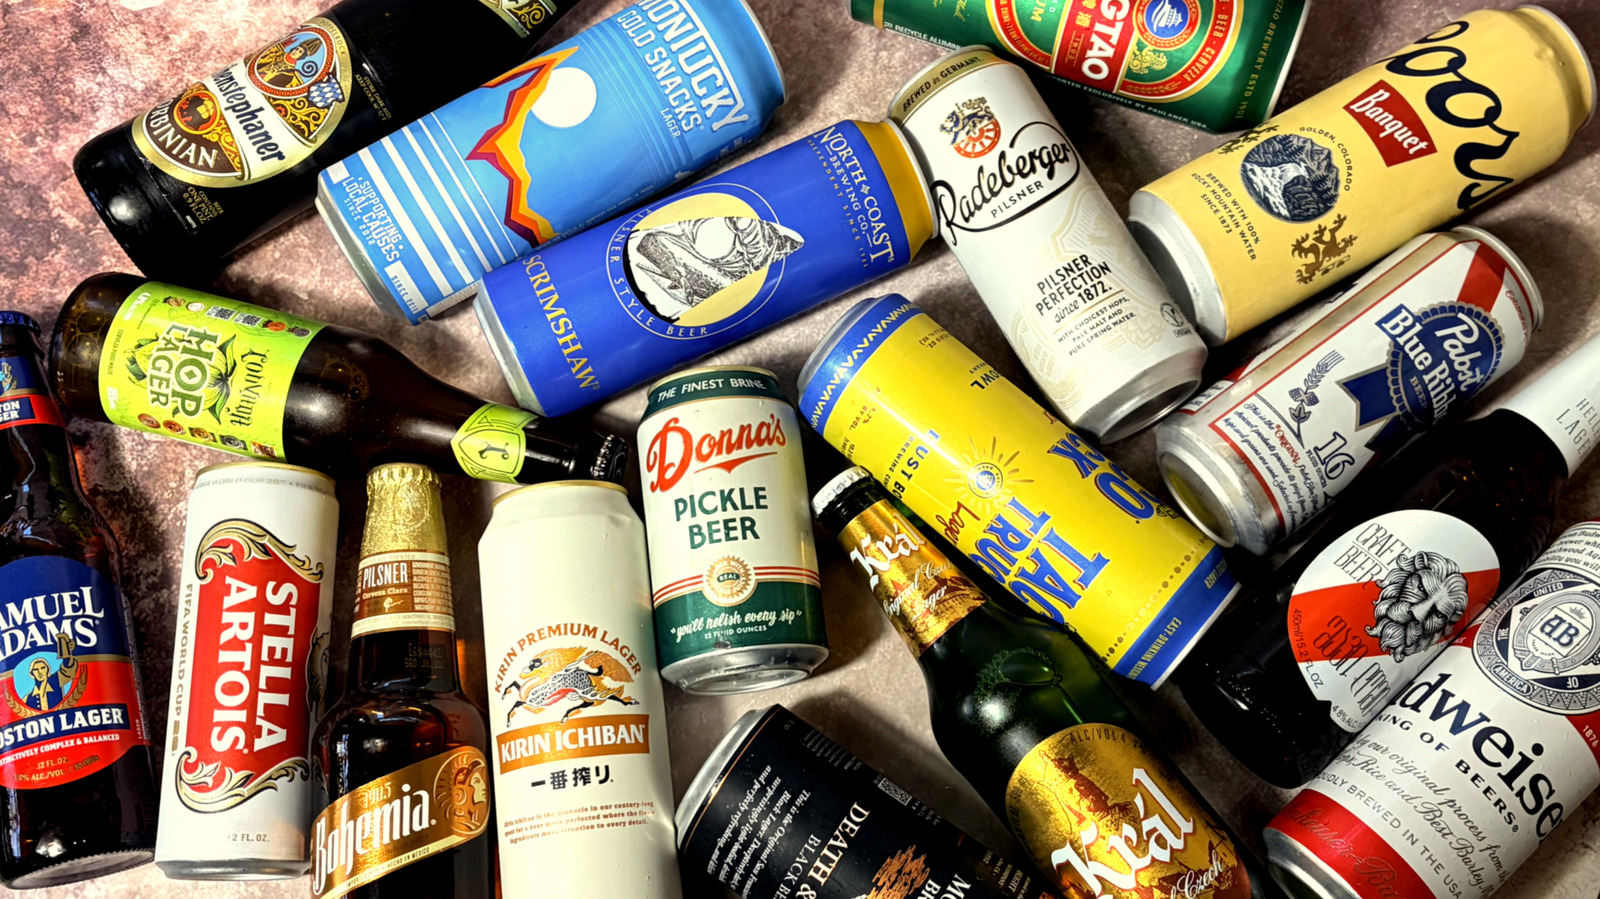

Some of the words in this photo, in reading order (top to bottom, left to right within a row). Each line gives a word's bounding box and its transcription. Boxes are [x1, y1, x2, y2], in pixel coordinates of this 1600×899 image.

[895, 24, 928, 41] RECYCLE
[1212, 14, 1228, 38] BEER
[1255, 23, 1277, 71] BREWERY
[617, 10, 656, 48] COLD
[645, 46, 702, 132] SNACKS
[1182, 47, 1216, 82] CERVEZA
[902, 81, 932, 112] BREWED
[1083, 86, 1133, 105] EXCLUSIVELY
[1148, 107, 1188, 123] PAULANER
[150, 98, 219, 169] ORBINIAN
[660, 107, 681, 138] LAGER
[1349, 88, 1429, 155] Banquet
[1299, 126, 1336, 143] GOLDEN,
[1337, 142, 1353, 192] COLORADO
[187, 186, 201, 203] ONE
[359, 180, 402, 244] SUPPORTING
[813, 126, 867, 185] NORTH
[863, 196, 894, 262] COAST
[830, 155, 862, 211] BREWING
[857, 214, 869, 234] CO.
[930, 141, 1072, 246] Radeberger
[990, 180, 1044, 218] PILSNER
[1200, 193, 1219, 215] SINCE
[1218, 216, 1233, 235] 1873
[1206, 172, 1232, 198] BREWED
[1231, 199, 1249, 221] WITH
[1245, 222, 1261, 245] 100%
[342, 177, 369, 213] LOCAL
[362, 211, 400, 262] CAUSES
[344, 198, 361, 221] SINCE
[359, 224, 376, 246] 2012
[610, 209, 652, 263] PILSNER
[1191, 172, 1211, 193] ROCKY
[1209, 189, 1241, 229] MOUNTAIN
[1238, 230, 1257, 261] WATER
[1035, 261, 1112, 316] PERFECTION
[1036, 254, 1092, 295] PILSNER
[522, 254, 598, 390] SCRIMSHAW
[614, 277, 655, 326] STYLE
[1054, 299, 1080, 323] since
[1077, 281, 1113, 304] 1872.
[666, 325, 708, 337] BEER
[1058, 330, 1074, 343] WITH
[1074, 307, 1108, 330] CHOICEST
[1069, 342, 1086, 357] PURE
[1087, 326, 1112, 343] SPRING
[1113, 312, 1137, 326] WATER.
[1072, 329, 1089, 343] PALE
[1089, 319, 1107, 332] MALT
[1108, 309, 1123, 321] AND
[1381, 308, 1433, 371] Blue
[149, 323, 190, 407] LAGER
[171, 327, 220, 418] HOP
[1434, 312, 1484, 392] Pabst
[657, 387, 677, 402] THE
[681, 378, 725, 394] FINEST
[730, 378, 766, 390] BRINE
[1245, 401, 1261, 417] This
[646, 413, 786, 493] Donna's
[1306, 449, 1320, 468] FLUID
[1313, 431, 1355, 480] 16
[674, 486, 768, 522] PICKLE
[688, 516, 760, 550] BEER
[850, 512, 926, 592] Král
[362, 562, 408, 589] PILSNER
[1333, 545, 1382, 590] BEER
[1567, 558, 1582, 567] you
[184, 584, 193, 616] FIFA
[362, 591, 386, 600] Cerveza
[387, 587, 408, 595] Clara
[1533, 582, 1564, 598] UNITED
[0, 617, 98, 661] DAMS
[706, 611, 742, 629] relish
[745, 610, 777, 626] every
[736, 625, 767, 634] OUNCES
[1141, 617, 1182, 662] EASY-DRINKING
[1498, 627, 1509, 640] THE
[1540, 613, 1580, 648] AB
[178, 622, 190, 679] WORLD
[210, 576, 257, 753] ARTOIS
[254, 581, 298, 752] STELLA
[494, 648, 518, 693] KIRIN
[517, 623, 599, 651] PREMIUM
[600, 631, 643, 676] LAGER
[1493, 664, 1529, 693] AMERICA
[1566, 677, 1579, 688] OF
[60, 707, 124, 730] LAGER
[175, 684, 184, 716] CUP
[40, 739, 75, 753] COMPLEX
[76, 737, 83, 745] &
[83, 733, 120, 744] BALANCED
[501, 732, 550, 763] KIRIN
[555, 724, 644, 751] ICHIBAN
[1070, 727, 1116, 745] ALC/VOL
[1582, 724, 1599, 747] 1876
[759, 766, 771, 782] and
[1391, 671, 1564, 847] dweise
[1419, 732, 1450, 752] OF
[1455, 759, 1515, 828] BEERS
[747, 775, 782, 824] surprisingly
[773, 791, 790, 813] Black
[795, 789, 809, 806] This
[1368, 740, 1391, 755] our
[1389, 752, 1447, 796] original
[1445, 792, 1487, 843] process
[1486, 842, 1504, 876] from
[313, 784, 430, 896] Bohemia
[565, 814, 600, 824] perfected
[782, 814, 793, 826] the
[1051, 768, 1193, 899] Král
[1353, 753, 1387, 782] Rice
[1384, 779, 1415, 805] and
[1413, 799, 1455, 840] Best
[1449, 836, 1485, 889] Barley
[758, 826, 785, 861] Original
[784, 833, 822, 885] BLACK
[808, 801, 871, 886] DEATH
[1347, 784, 1402, 829] BREWED
[1402, 829, 1418, 846] IN
[1420, 846, 1445, 876] THE
[1444, 877, 1462, 899] USA
[753, 861, 764, 874] San
[1177, 850, 1223, 899] Czech
[796, 883, 817, 899] &
